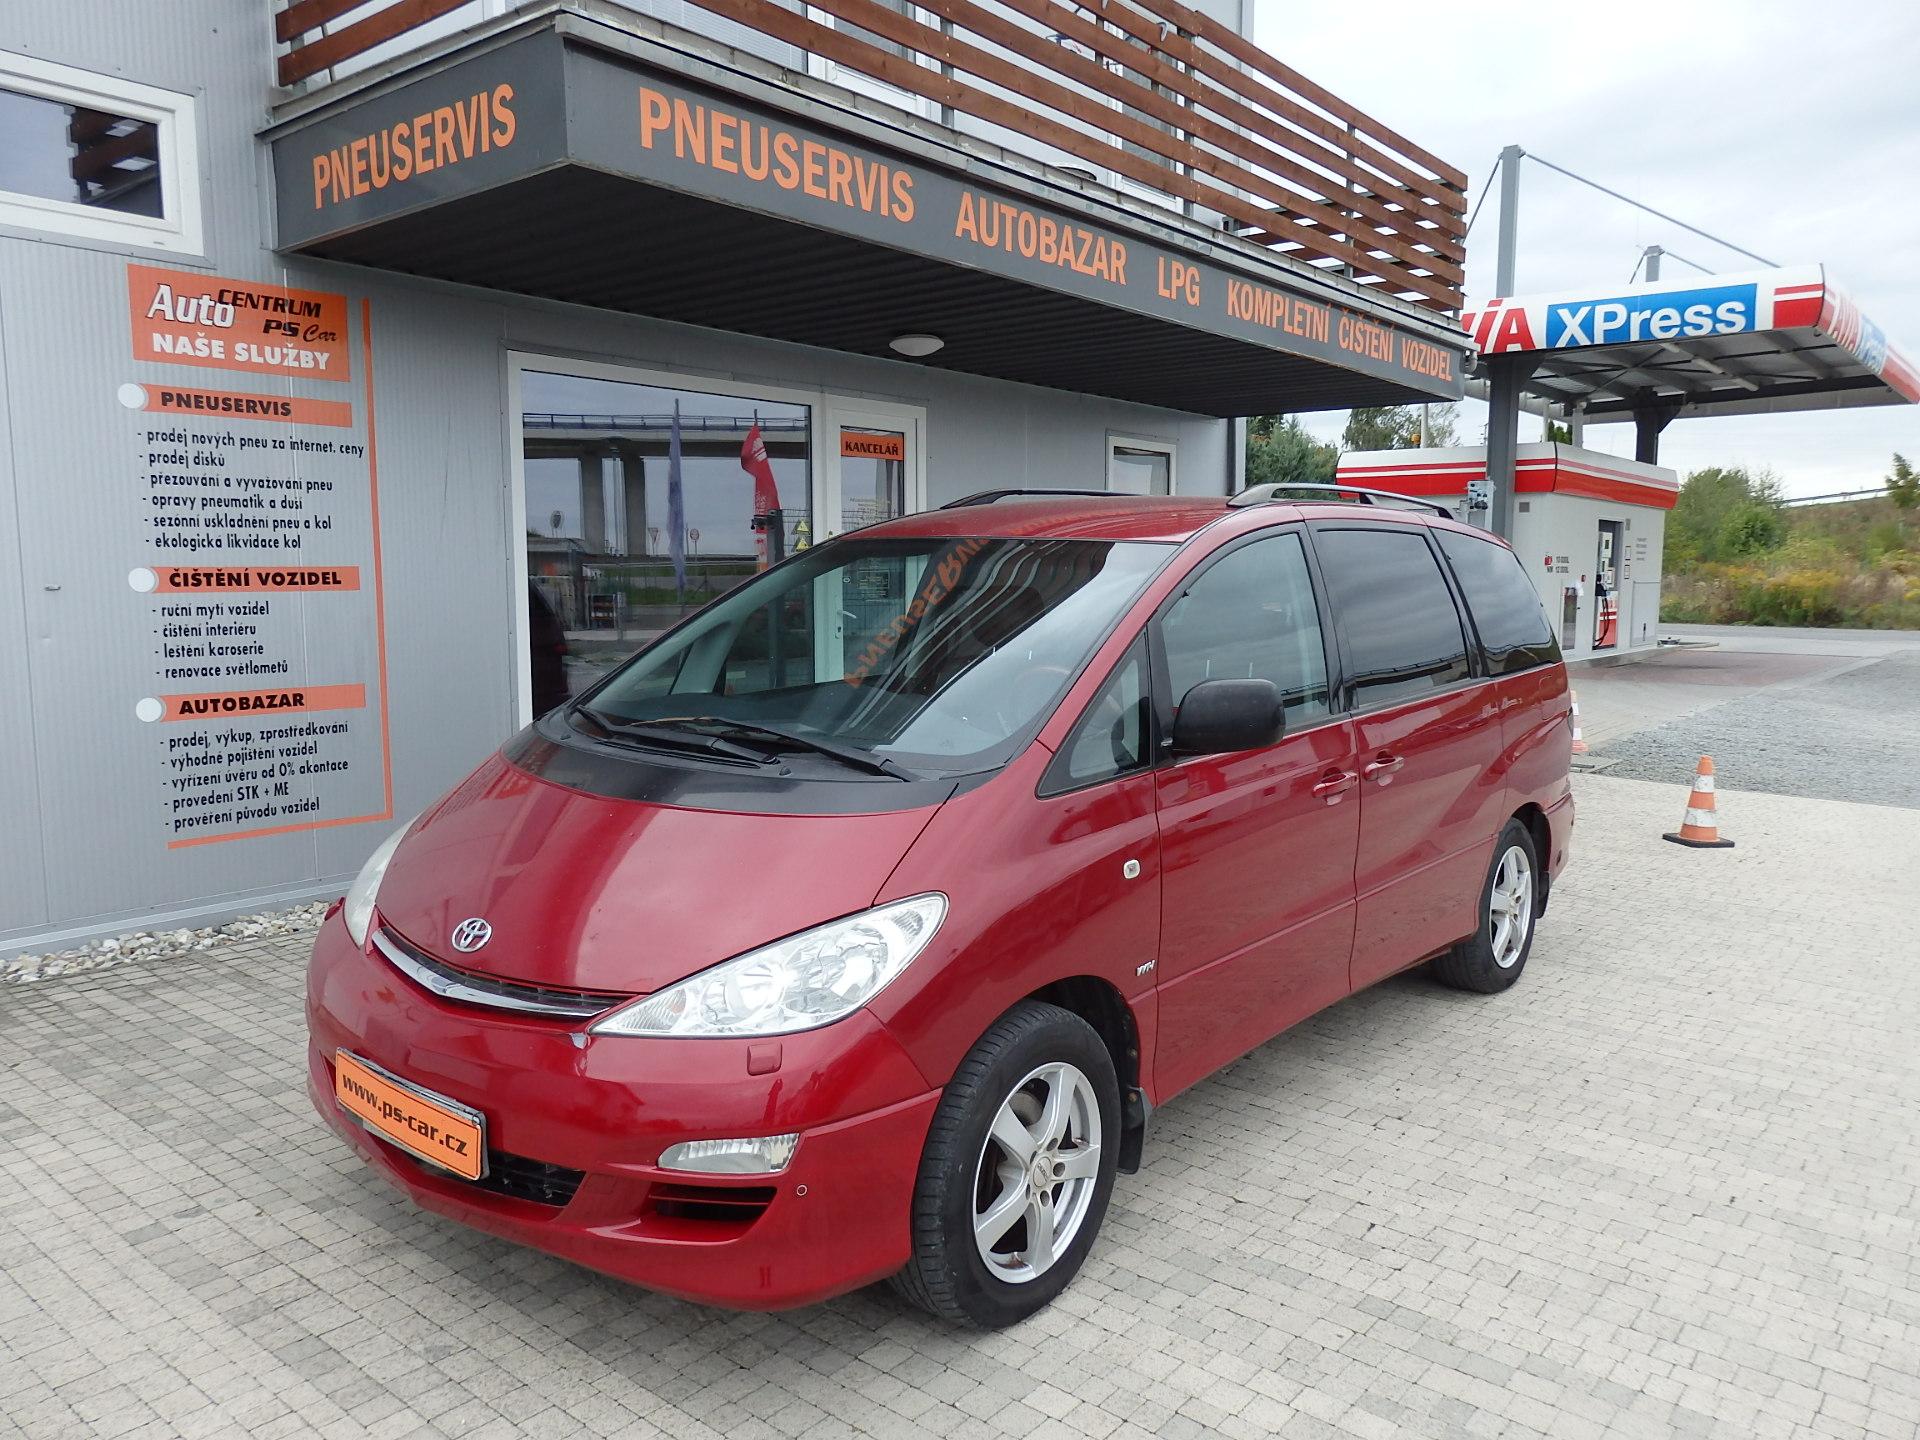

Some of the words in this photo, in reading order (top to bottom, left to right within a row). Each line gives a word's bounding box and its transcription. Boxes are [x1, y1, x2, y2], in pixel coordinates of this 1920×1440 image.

[312, 83, 517, 210] PNEUSERVIS
[638, 86, 915, 223] PNEUSERVIS
[955, 191, 1128, 286] AUTOBAZAR
[1158, 256, 1200, 307] LPG
[1227, 278, 1332, 343] KOMPLETNÍ
[1338, 307, 1395, 363] ČIŠTĚNÍ
[1402, 337, 1453, 382] VOZIDEL
[146, 283, 235, 328] Auto
[217, 289, 321, 318] CENTRUM
[262, 319, 300, 338] PS
[302, 324, 337, 342] Car
[1555, 301, 1747, 348] XPress
[152, 332, 225, 359] NAŠE
[234, 343, 330, 370] SLUŽBY
[161, 391, 292, 416] PNEUSERVIS
[147, 428, 188, 449] prodej
[192, 431, 235, 449] nových
[239, 435, 268, 450] pneu
[271, 439, 286, 449] za
[289, 436, 336, 453] internet.
[339, 444, 364, 458] ceny
[845, 441, 899, 456] KANCELÁŘ
[149, 449, 190, 468] prodej
[193, 451, 225, 467] disků
[150, 472, 220, 488] přezouvání
[224, 477, 231, 488] a
[235, 475, 302, 492] vyvažování
[306, 480, 333, 494] pneu
[152, 495, 197, 510] opravy
[201, 494, 264, 510] pneumatik
[269, 500, 277, 509] a
[280, 495, 302, 510] duší
[153, 514, 200, 528] sezónní
[204, 513, 269, 529] uskladnění
[273, 518, 300, 532] pneu
[304, 519, 311, 529] a
[315, 515, 332, 530] kol
[155, 532, 222, 552] ekologická
[227, 534, 280, 549] likvidace
[283, 534, 301, 549] kol
[169, 567, 250, 587] ČIŠTĚNÍ
[257, 571, 342, 586] VOZIDEL
[161, 603, 192, 617] ruční
[196, 603, 224, 620] mytí
[228, 601, 270, 616] vozidel
[162, 623, 202, 637] čištění
[205, 621, 256, 636] interiéru
[163, 643, 205, 658] leštění
[208, 641, 264, 656] karoserie
[165, 664, 221, 679] renovace
[225, 660, 288, 676] světlometů
[178, 693, 305, 715] AUTOBAZAR
[169, 730, 211, 751] prodej,
[215, 728, 255, 747] výkup,
[259, 721, 348, 742] zprostředkování
[170, 751, 223, 771] výhodné
[227, 746, 275, 766] pojištění
[278, 742, 318, 757] vozidel
[171, 773, 221, 792] vyřízení
[225, 768, 258, 783] úvěru
[261, 763, 275, 779] od
[279, 761, 296, 777] 0%
[299, 759, 349, 776] akontace
[173, 789, 234, 812] provedení
[237, 782, 260, 801] STK
[274, 781, 289, 798] ME
[174, 809, 233, 832] prověření
[236, 804, 277, 824] původu
[281, 797, 320, 816] vozidel
[342, 1074, 468, 1157] www.ps-car.cz
